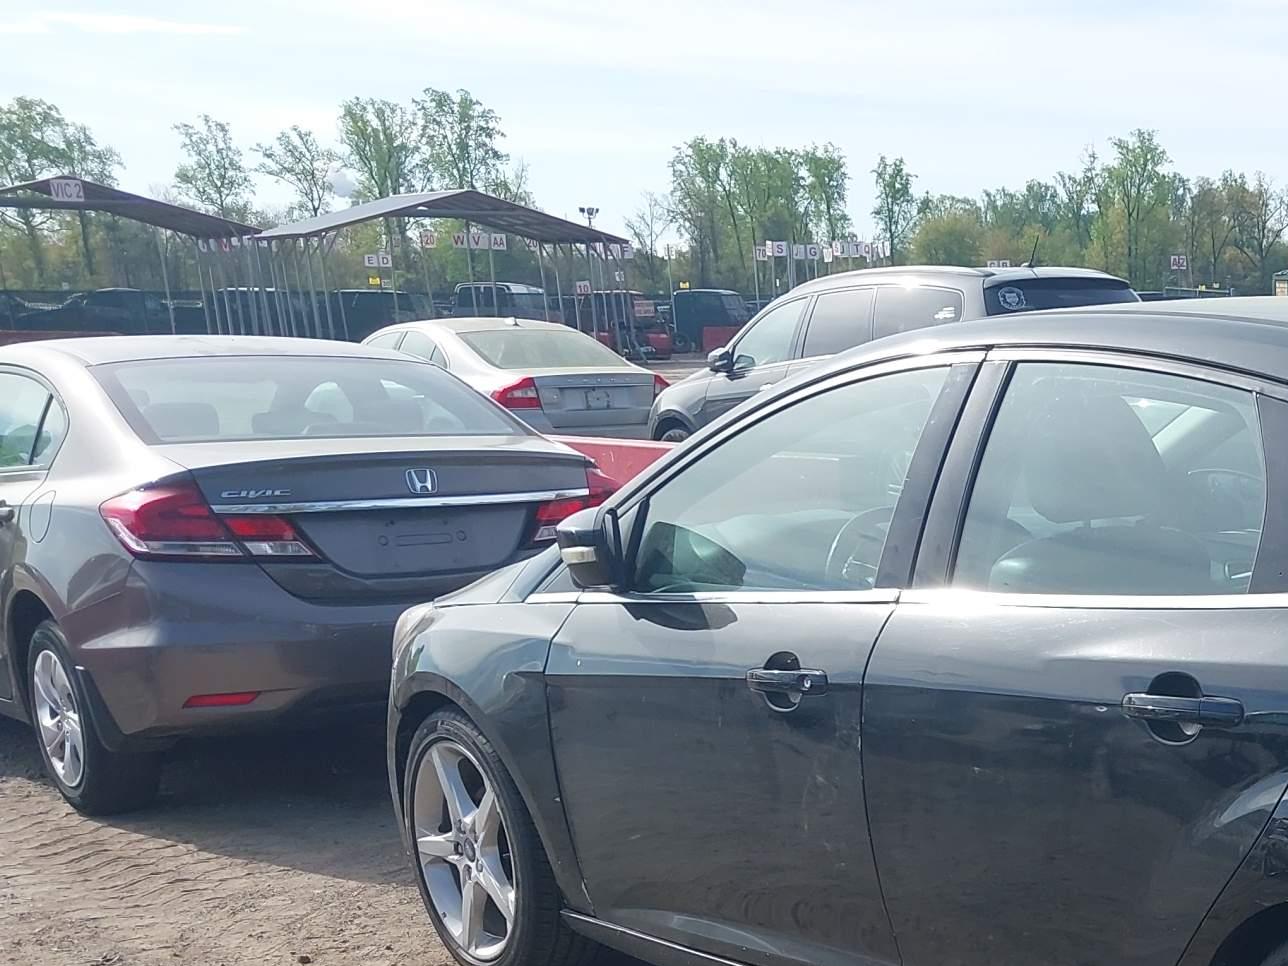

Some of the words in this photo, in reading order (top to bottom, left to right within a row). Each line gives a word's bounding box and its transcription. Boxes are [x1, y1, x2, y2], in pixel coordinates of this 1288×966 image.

[50, 182, 73, 199] VIC
[74, 183, 83, 199] 2
[452, 234, 465, 246] W
[776, 244, 784, 254] S
[809, 247, 817, 257] G
[367, 256, 375, 265] E
[381, 256, 389, 265] D
[221, 488, 292, 499] CIVIC
